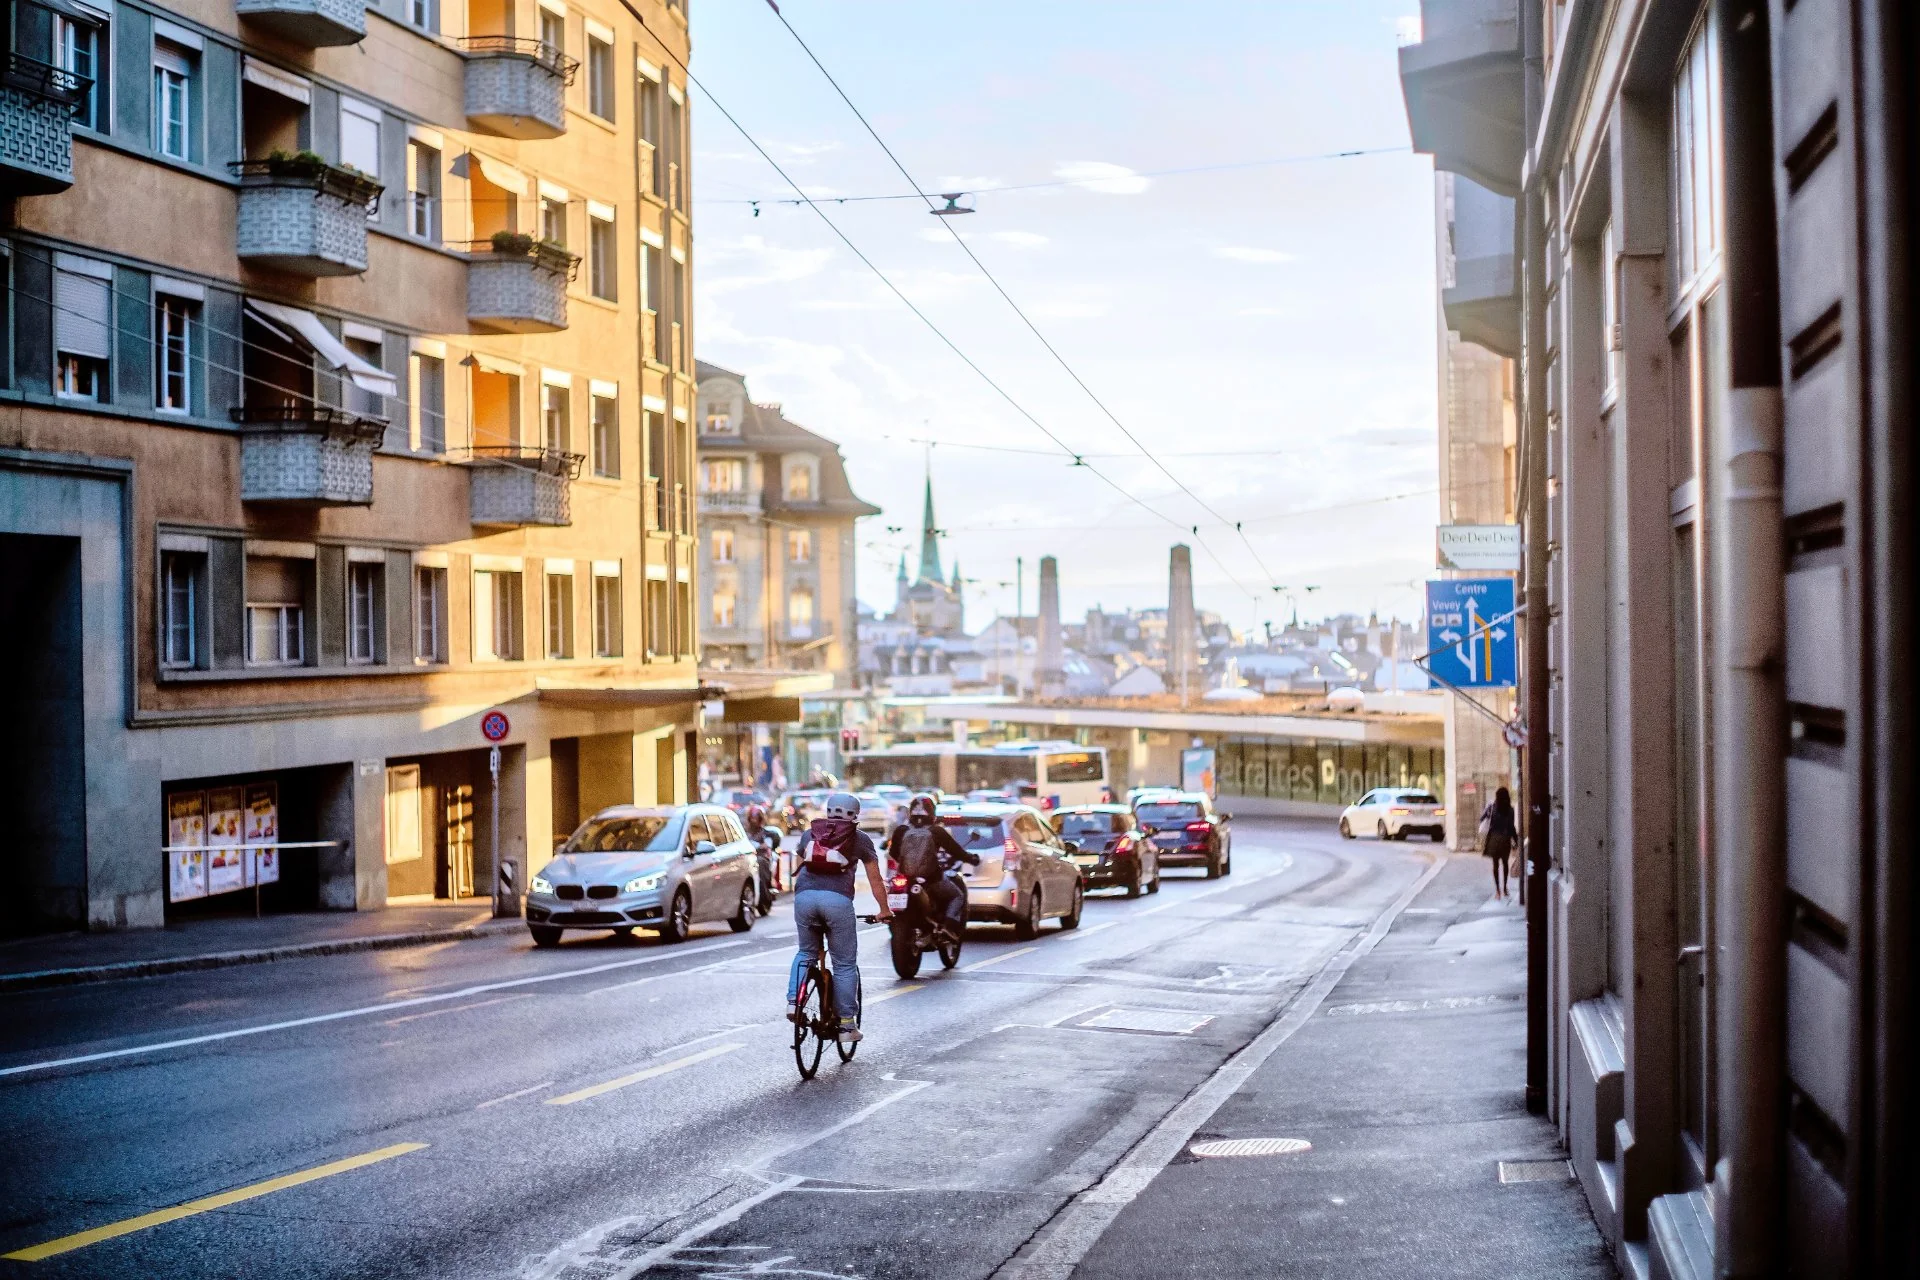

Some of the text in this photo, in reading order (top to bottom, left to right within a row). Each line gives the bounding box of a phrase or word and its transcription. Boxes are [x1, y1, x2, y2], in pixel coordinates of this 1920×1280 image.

[1442, 531, 1519, 543] DeeDeeDee
[1455, 584, 1487, 594] Centre
[1432, 600, 1460, 612] Vevey
[1221, 758, 1314, 793] etraites
